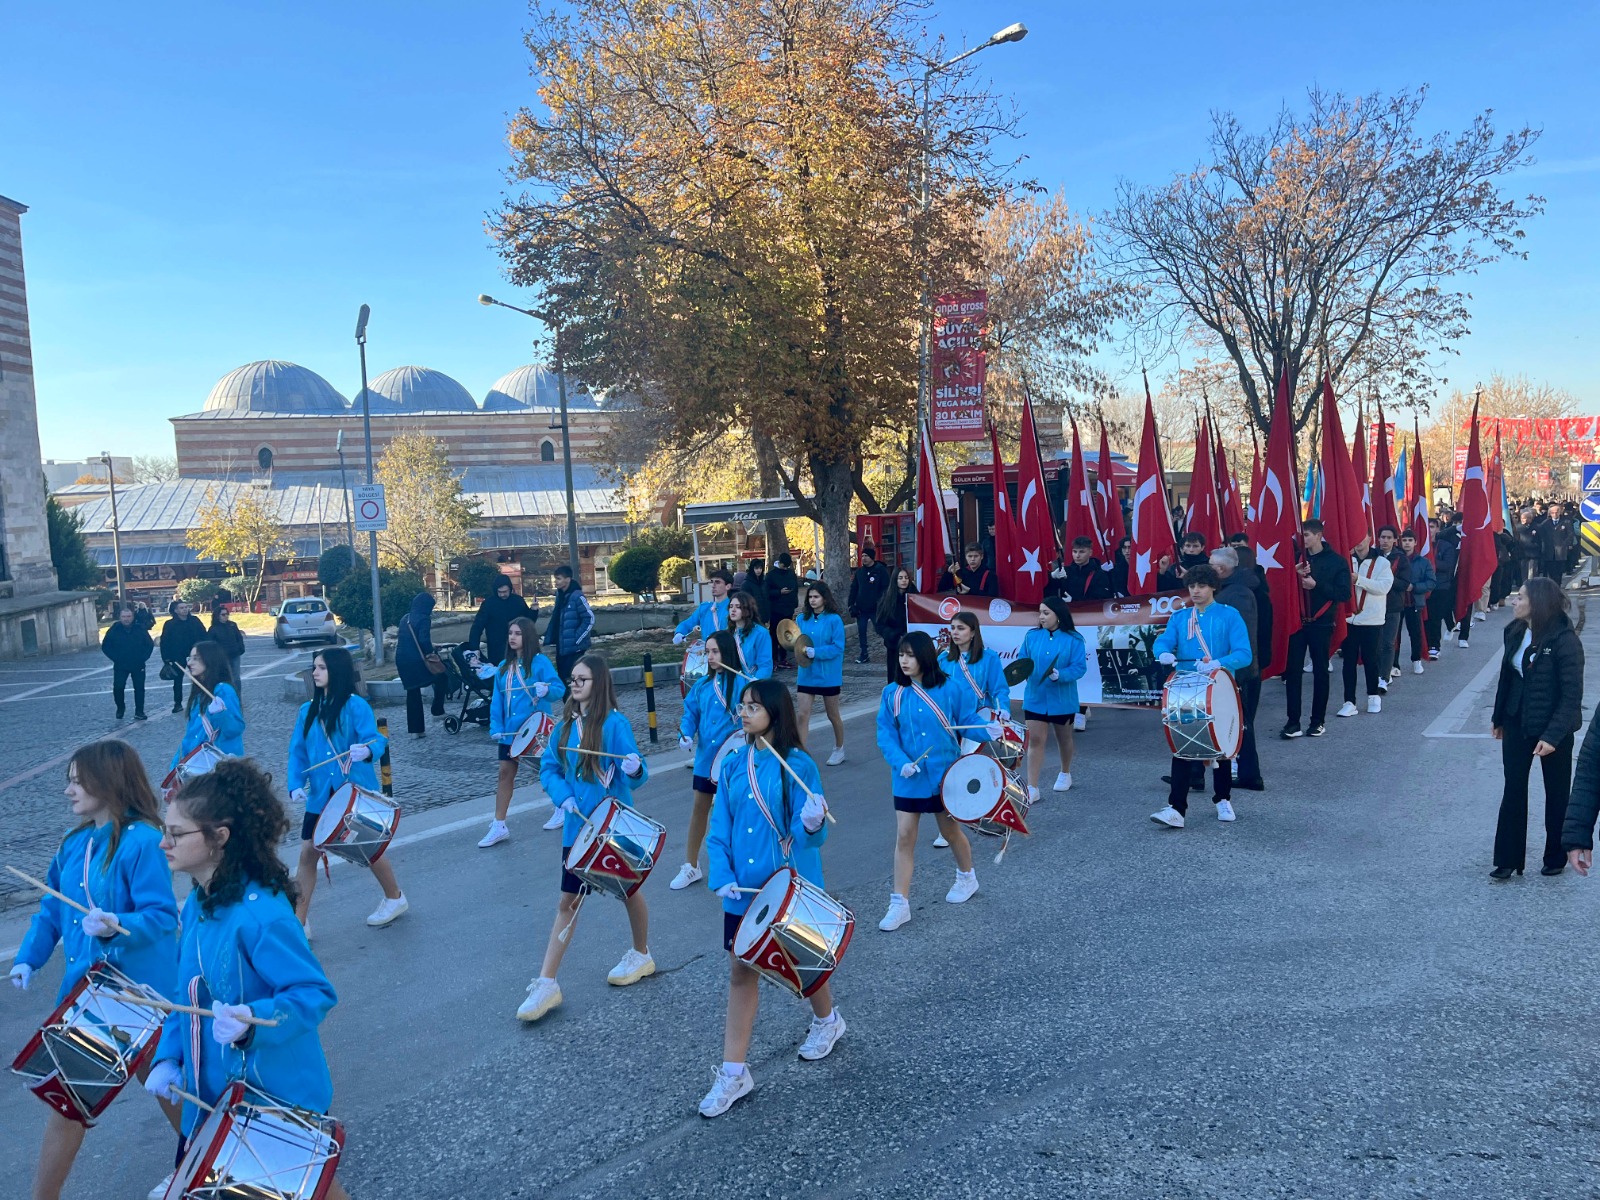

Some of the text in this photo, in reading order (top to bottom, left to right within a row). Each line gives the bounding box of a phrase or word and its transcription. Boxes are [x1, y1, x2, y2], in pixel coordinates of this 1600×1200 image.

[960, 301, 984, 314] gross
[936, 400, 959, 408] VEGA
[935, 411, 949, 420] 30
